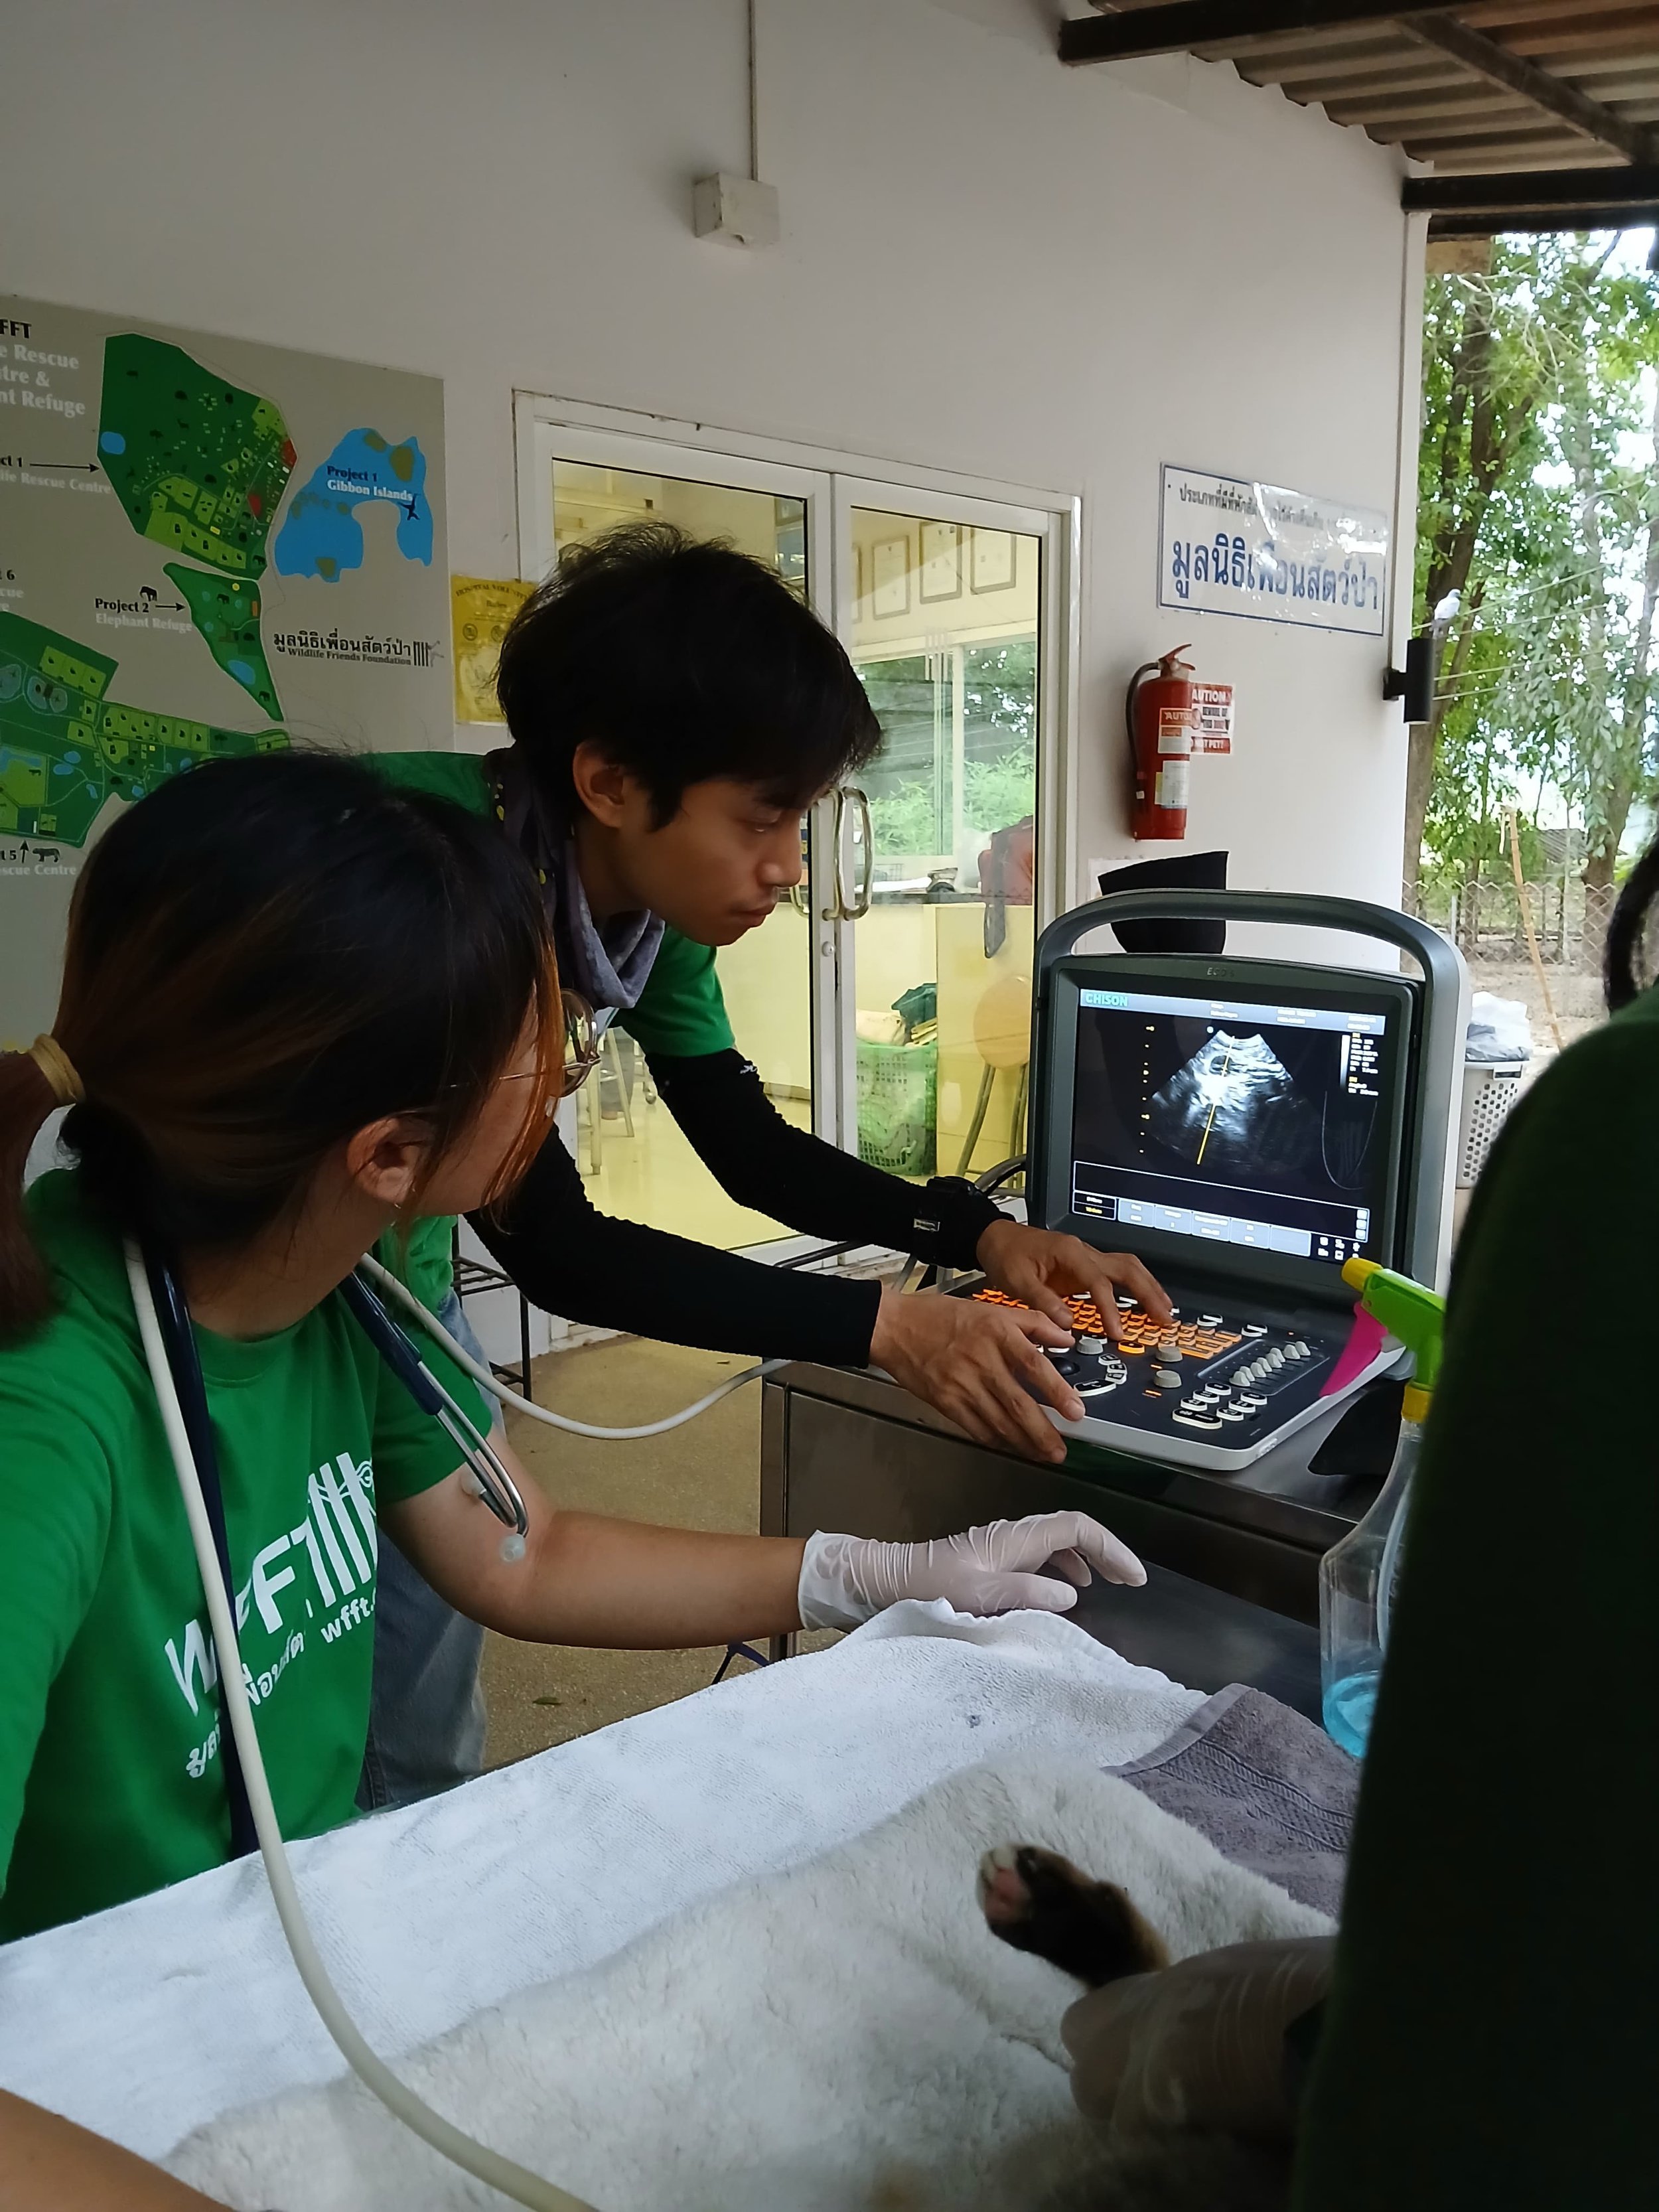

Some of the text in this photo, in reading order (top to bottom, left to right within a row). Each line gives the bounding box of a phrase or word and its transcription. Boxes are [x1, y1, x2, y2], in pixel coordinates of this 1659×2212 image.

[14, 344, 79, 369] Rescue
[0, 366, 50, 388] tre &
[21, 390, 86, 419] Refuge
[17, 457, 23, 468] 1
[327, 465, 378, 482] Project 1
[21, 472, 66, 489] Rescue
[69, 478, 113, 494] Centre
[327, 479, 413, 502] Gibbon Islands
[6, 569, 15, 581] 6
[95, 598, 149, 613] Project 2
[96, 613, 192, 634] Elephant Refuge
[287, 648, 411, 666] Wildlife Friends Foundation
[1191, 689, 1226, 702] AUTION
[34, 864, 76, 875] Centre
[1085, 992, 1129, 1007] CHISON
[321, 1587, 376, 1643] wfft.
